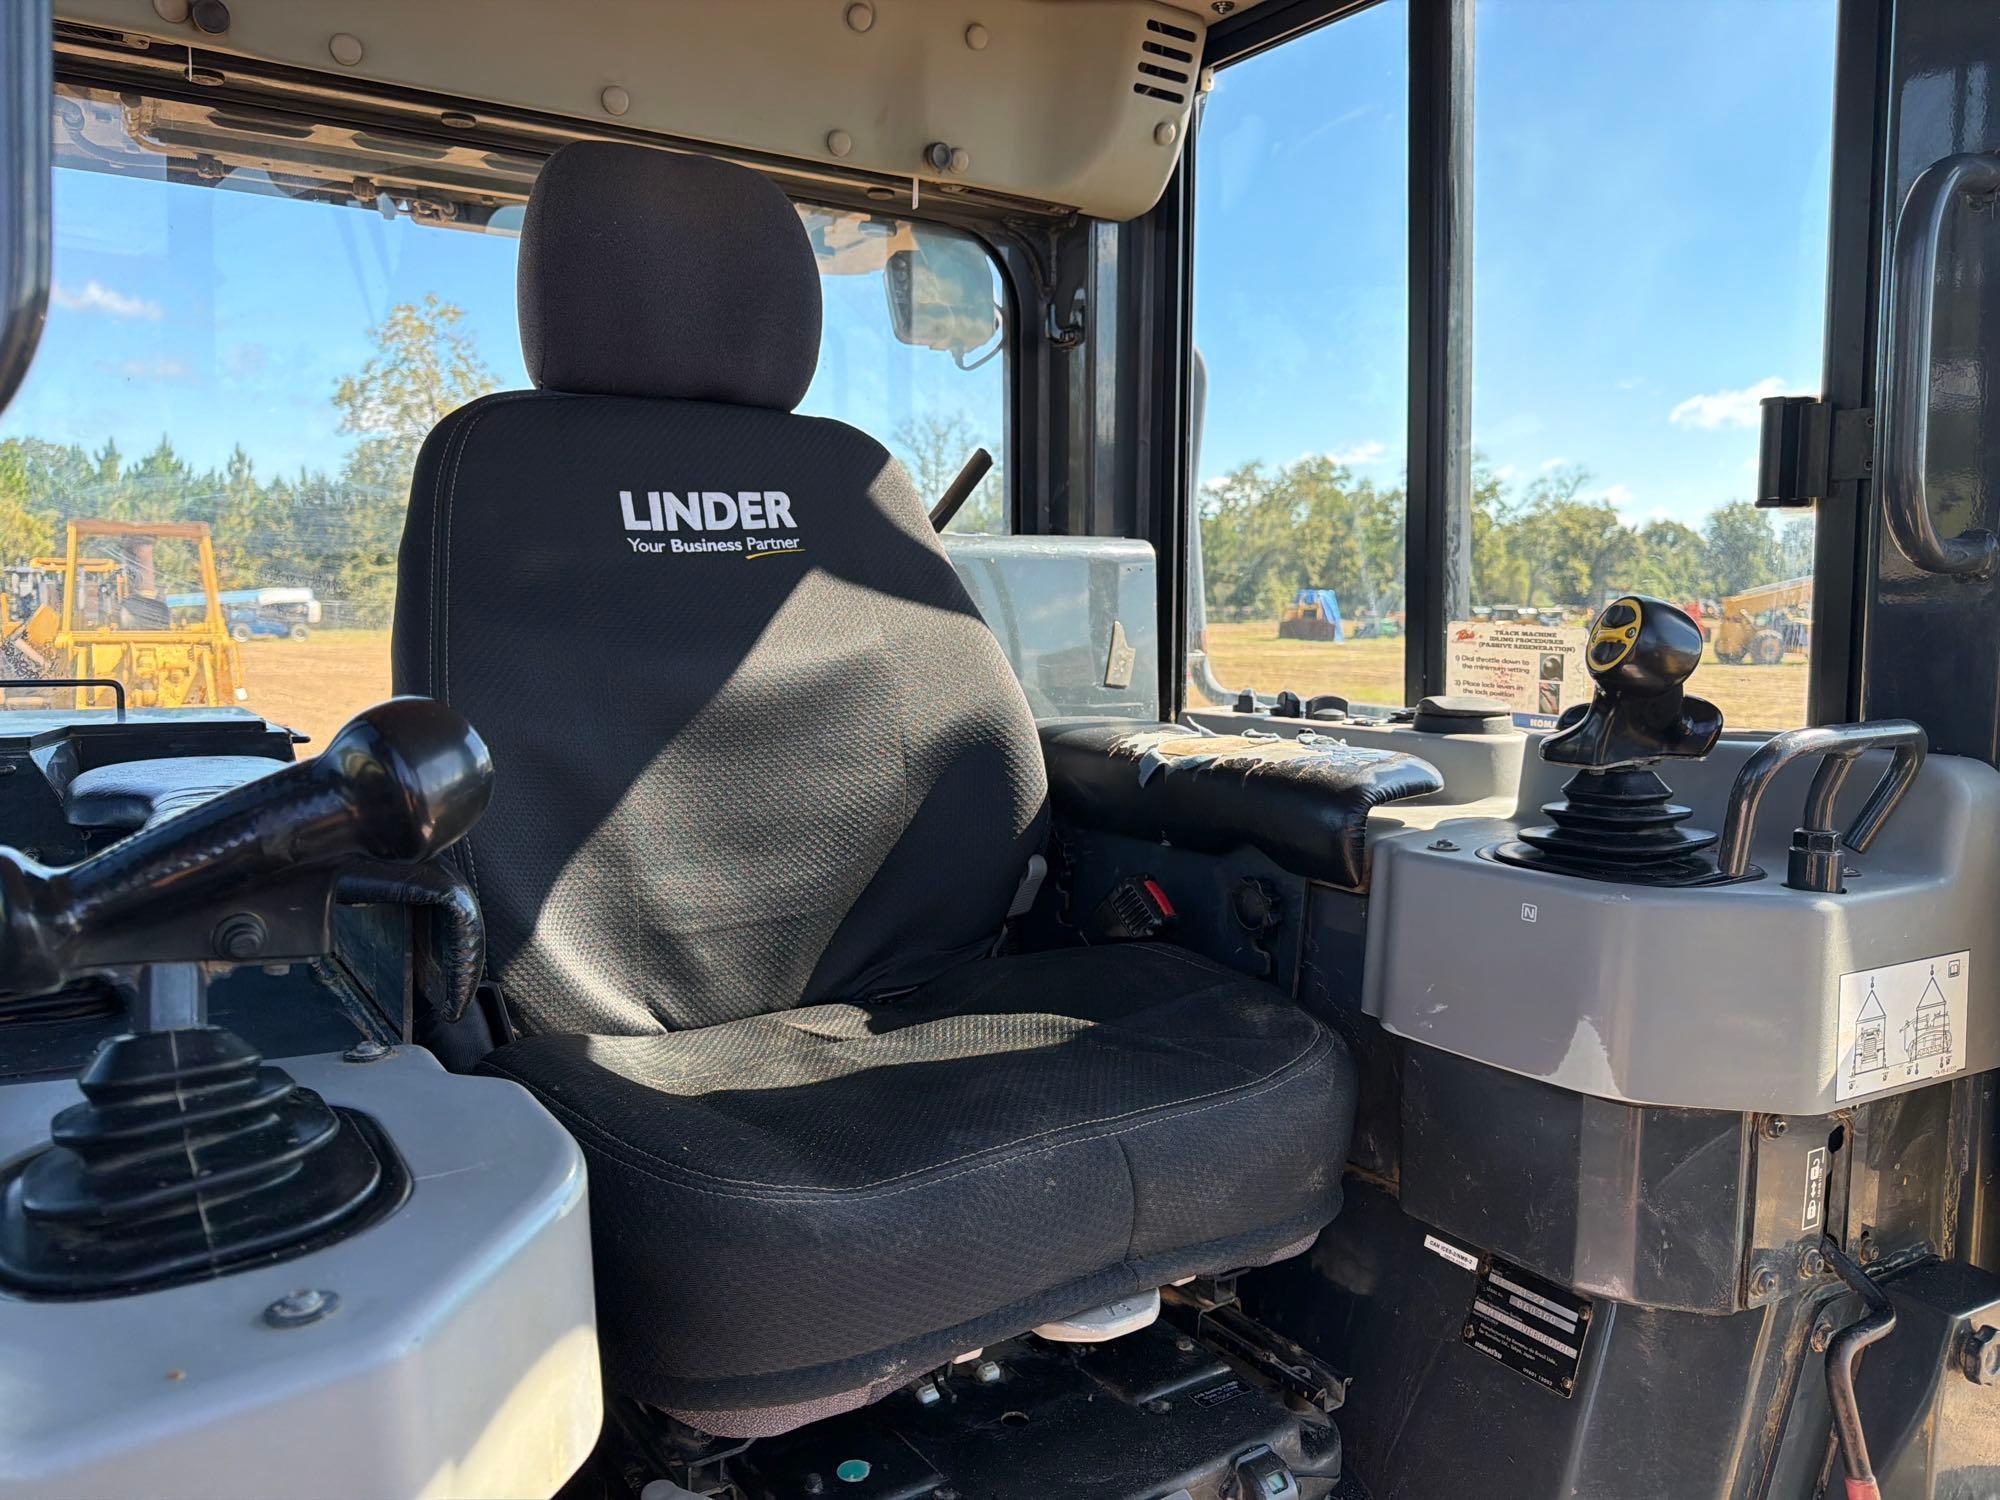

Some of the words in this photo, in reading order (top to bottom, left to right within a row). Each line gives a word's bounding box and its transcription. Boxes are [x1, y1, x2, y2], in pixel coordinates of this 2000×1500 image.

[619, 490, 798, 532] LINDER
[626, 537, 666, 553] Your
[670, 538, 743, 554] Business
[746, 536, 800, 551] Partner
[1494, 629, 1520, 637] TRACK
[1489, 635, 1514, 643] IDLING
[1515, 637, 1564, 645] PROCEDURES
[1478, 641, 1513, 649] (PASSIVE
[1513, 643, 1576, 653] REGENERATION)
[1476, 655, 1500, 664] throttle
[1474, 664, 1506, 672] minimum
[1507, 666, 1530, 674] setting
[1489, 690, 1515, 698] position
[1429, 1239, 1441, 1249] CAN
[1474, 1340, 1503, 1360] KOMATSU
